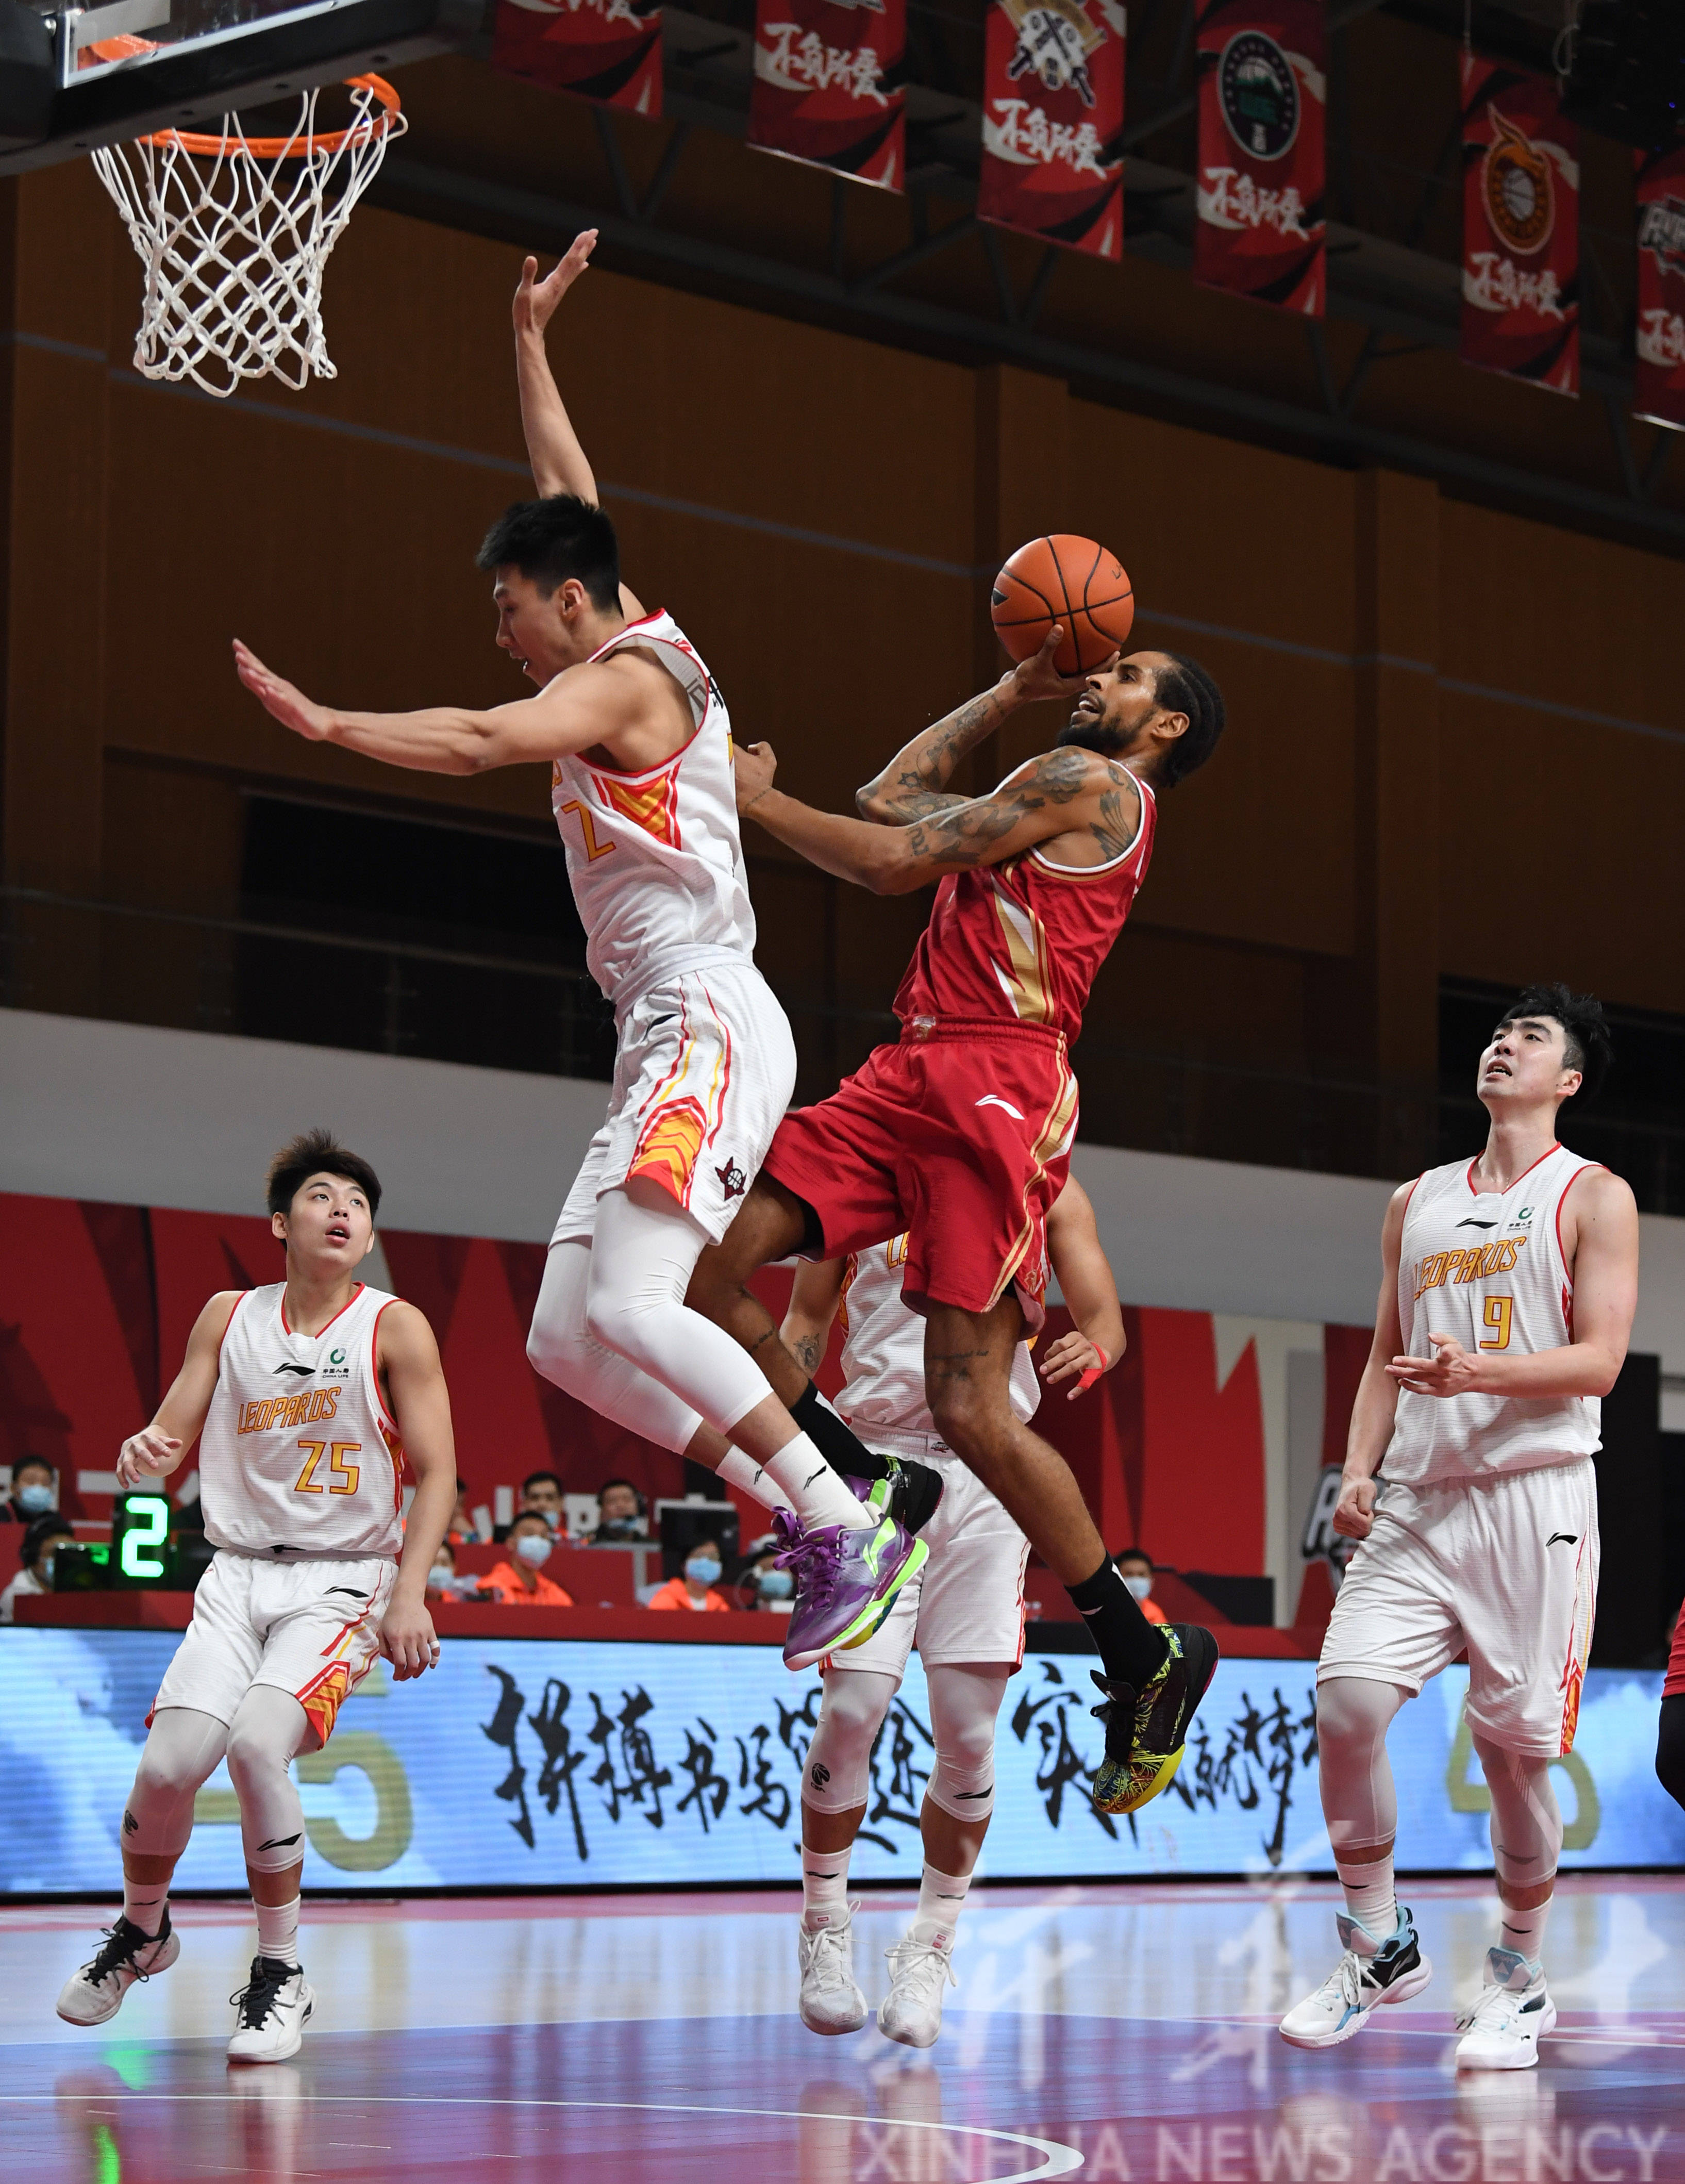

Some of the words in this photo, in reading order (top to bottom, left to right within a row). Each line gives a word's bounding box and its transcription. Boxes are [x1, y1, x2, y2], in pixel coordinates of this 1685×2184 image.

[561, 800, 616, 863] 2
[1414, 1236, 1527, 1300] LEOPARDS
[1479, 1296, 1513, 1350] 9
[238, 1386, 341, 1435] LEOPARDS
[294, 1440, 362, 1495] 25
[122, 1497, 168, 1578] 2
